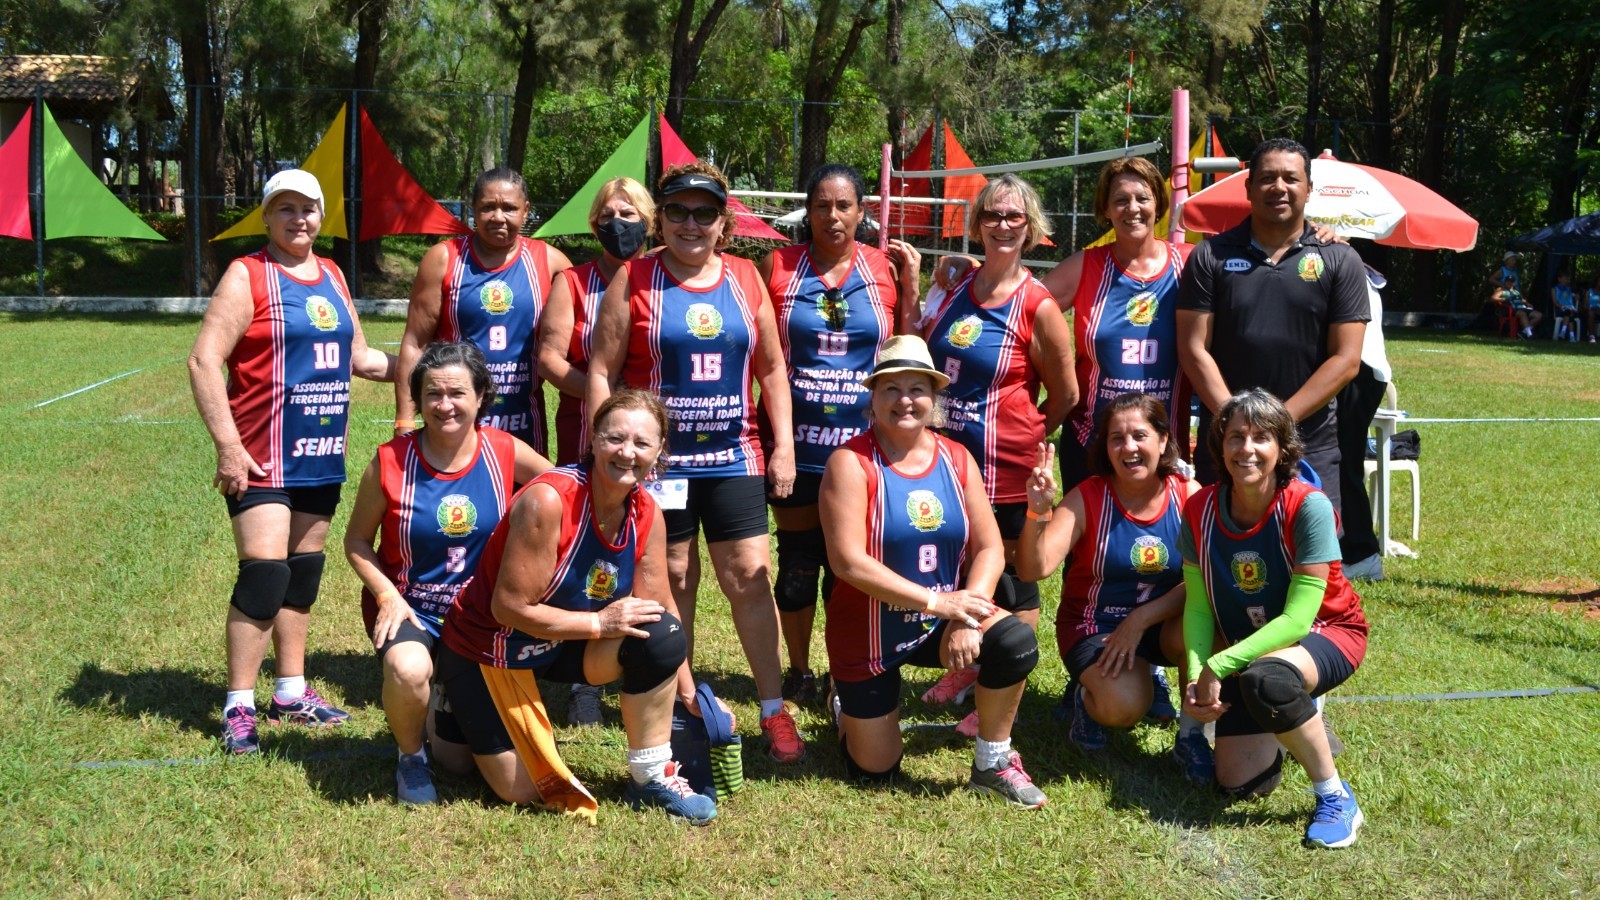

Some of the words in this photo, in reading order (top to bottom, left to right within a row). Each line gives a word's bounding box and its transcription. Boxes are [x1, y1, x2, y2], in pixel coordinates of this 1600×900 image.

[489, 325, 507, 351] 9
[313, 342, 339, 370] 10
[1121, 338, 1158, 365] 20
[519, 362, 528, 371] DA
[691, 353, 722, 381] 15
[508, 373, 530, 383] IDADE
[855, 370, 868, 380] DA
[293, 380, 344, 393] ASSOCIAÇÃO
[496, 385, 521, 394] AURU
[1102, 377, 1158, 392] ASSOCIAÇÃO
[1159, 379, 1170, 388] DA
[665, 394, 728, 409] ASSOCIAÇÃO
[729, 395, 740, 405] DA
[805, 392, 820, 402] DE
[822, 393, 858, 405] BAURU
[304, 406, 318, 416] DE
[964, 401, 978, 411] DA
[716, 407, 743, 419] IDADE
[951, 410, 980, 422] IDADE
[479, 413, 528, 431] EMEL
[677, 422, 694, 432] DE
[695, 421, 731, 432] BAURU
[292, 436, 344, 457] SEME
[446, 546, 467, 573] 3
[918, 544, 937, 573] 8
[1136, 582, 1156, 603] 7
[421, 601, 436, 612] DE
[904, 612, 919, 623] DE
